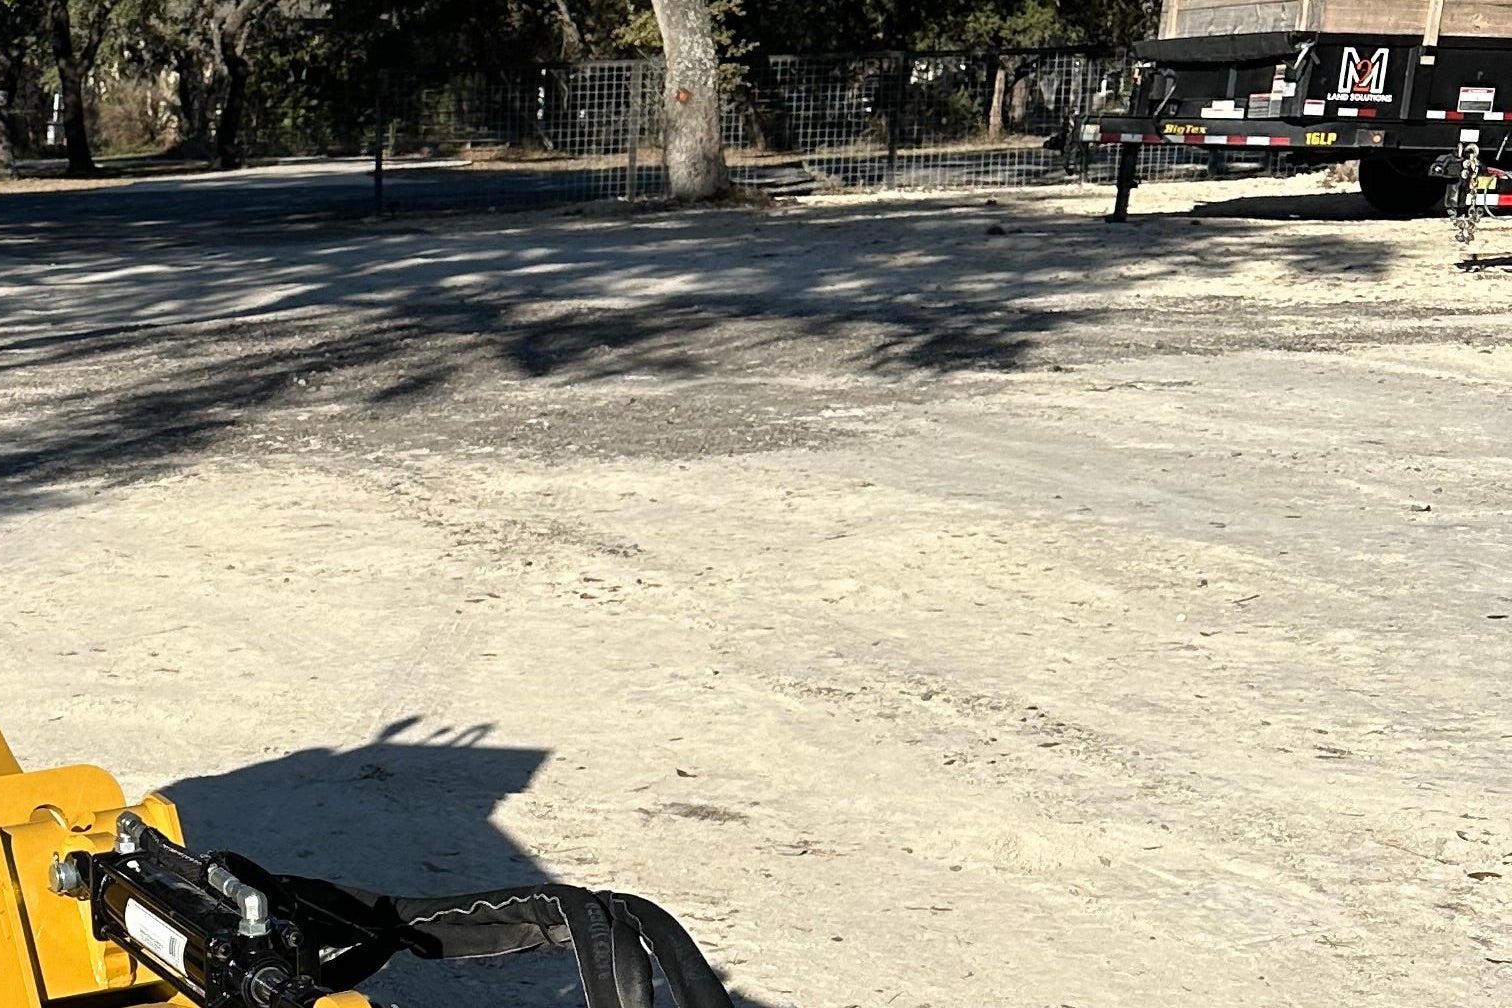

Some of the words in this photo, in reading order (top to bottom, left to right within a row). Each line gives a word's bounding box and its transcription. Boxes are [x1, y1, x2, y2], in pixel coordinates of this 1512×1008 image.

[1326, 92, 1349, 101] LAND
[1349, 93, 1393, 103] SOLUTIONS
[1305, 132, 1338, 146] 16LP
